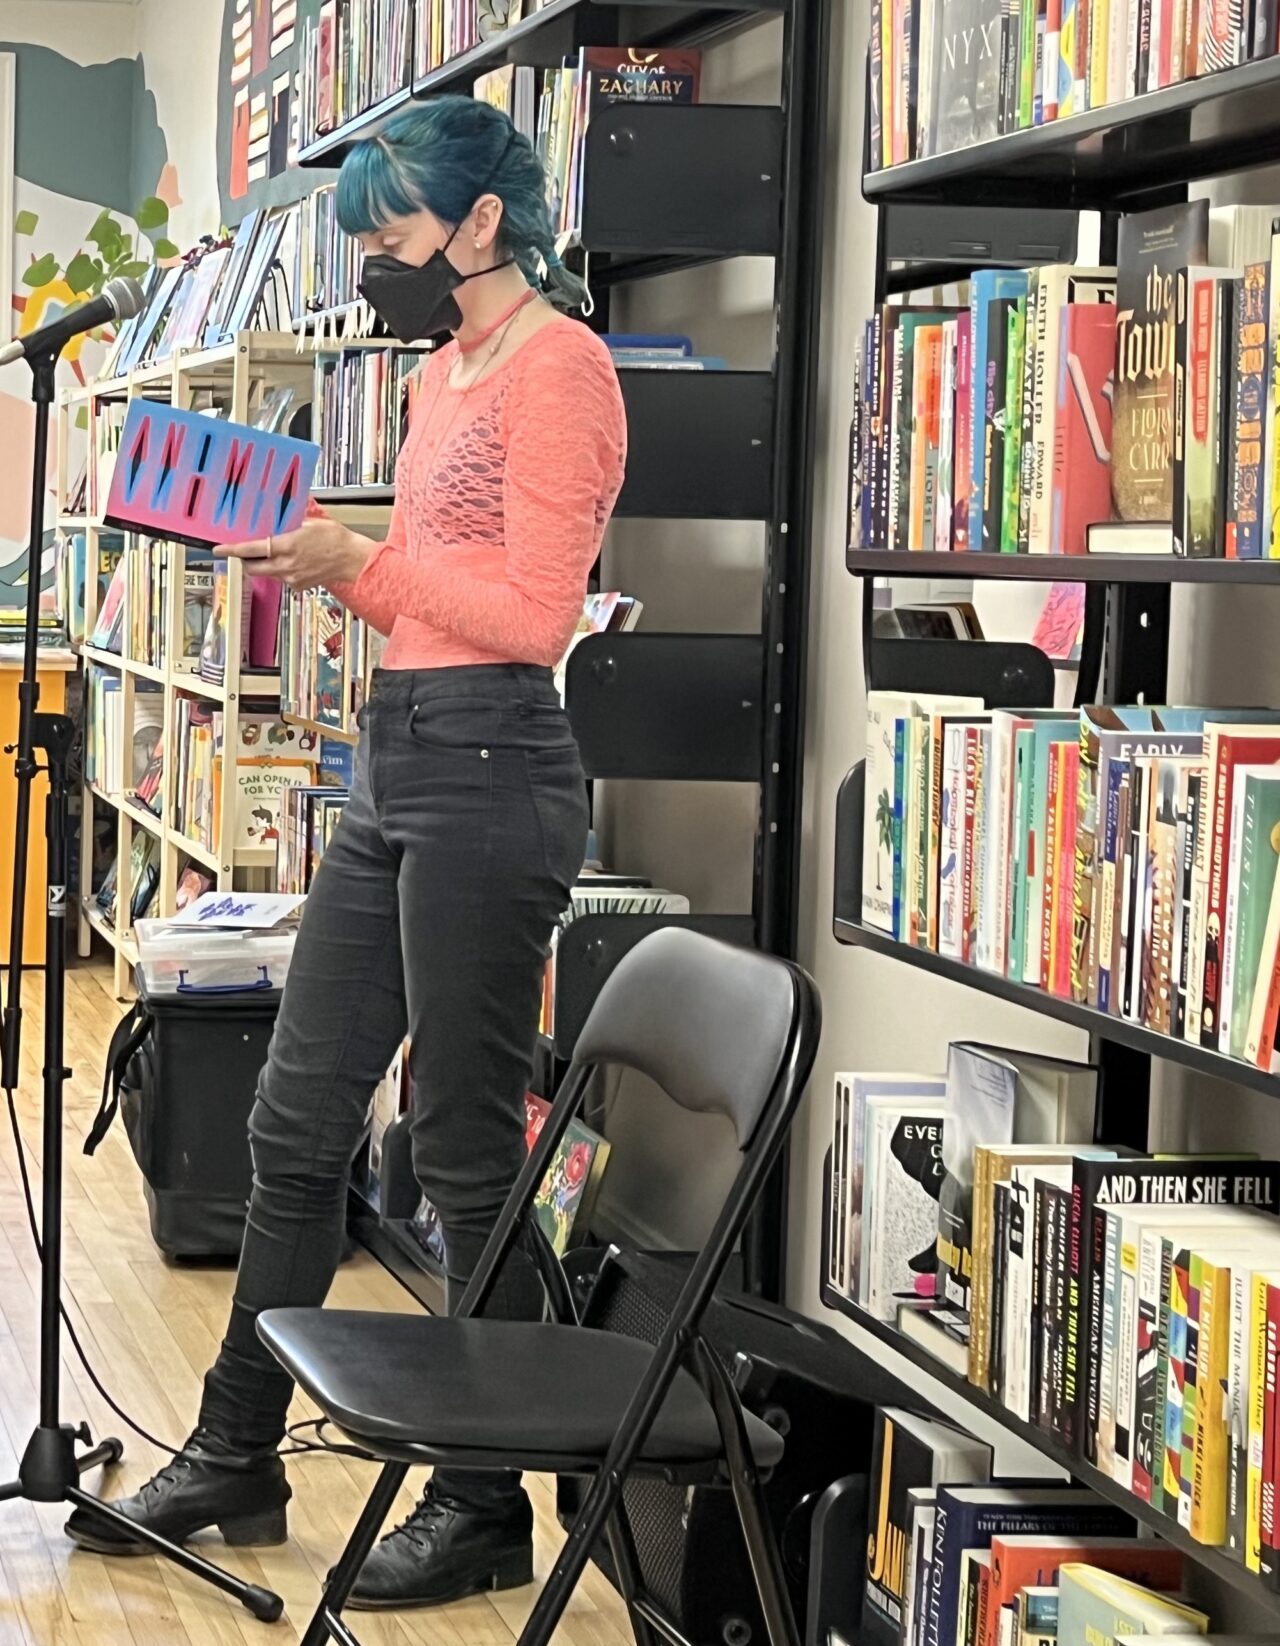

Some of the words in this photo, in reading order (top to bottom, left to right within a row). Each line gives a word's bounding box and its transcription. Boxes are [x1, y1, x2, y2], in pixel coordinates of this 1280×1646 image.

[942, 19, 995, 73] NYX
[600, 78, 684, 95] ZACHARY
[1038, 284, 1048, 340] EDITH
[1146, 264, 1173, 315] the
[1023, 342, 1033, 430] WATERS
[1034, 351, 1045, 425] HOLLER
[1035, 441, 1045, 500] EDWARD
[238, 775, 261, 786] CAN
[263, 774, 291, 787] OPEN
[244, 785, 263, 796] FOR
[1216, 774, 1227, 834] SISTERS
[1046, 807, 1055, 878] TALKING
[1192, 766, 1209, 872] LIBRARIANIST
[1241, 793, 1256, 896] TRUST
[1045, 882, 1052, 904] AT
[1211, 835, 1224, 909] BROTHERS
[1042, 908, 1051, 961] NIGHT
[1047, 1199, 1056, 1222] The
[1072, 1183, 1081, 1223] ALICIA
[1096, 1175, 1137, 1204] AND
[1140, 1175, 1187, 1204] THEN
[1188, 1176, 1227, 1204] SHE
[1233, 1177, 1273, 1205] FELL
[1046, 1223, 1055, 1264] Candy
[1058, 1197, 1067, 1272] JENNIFER
[1071, 1226, 1080, 1275] ELLIOTT
[1045, 1265, 1053, 1306] House
[1056, 1277, 1064, 1321] EGAN
[1069, 1277, 1079, 1307] AND
[1202, 1280, 1213, 1305] THE
[1234, 1276, 1243, 1324] JULIET
[1068, 1311, 1078, 1345] THEN
[1090, 1269, 1101, 1355] AMERICAN
[1067, 1345, 1077, 1372] SHE
[1199, 1310, 1211, 1382] MEASURE
[1233, 1329, 1242, 1359] THE
[1040, 1380, 1049, 1414] Egan
[1066, 1372, 1076, 1403] FELL
[1088, 1357, 1098, 1422] PSYCHO
[1231, 1363, 1241, 1421] MANIAC
[1196, 1423, 1204, 1462] NIKKI
[935, 1506, 948, 1554] KEN
